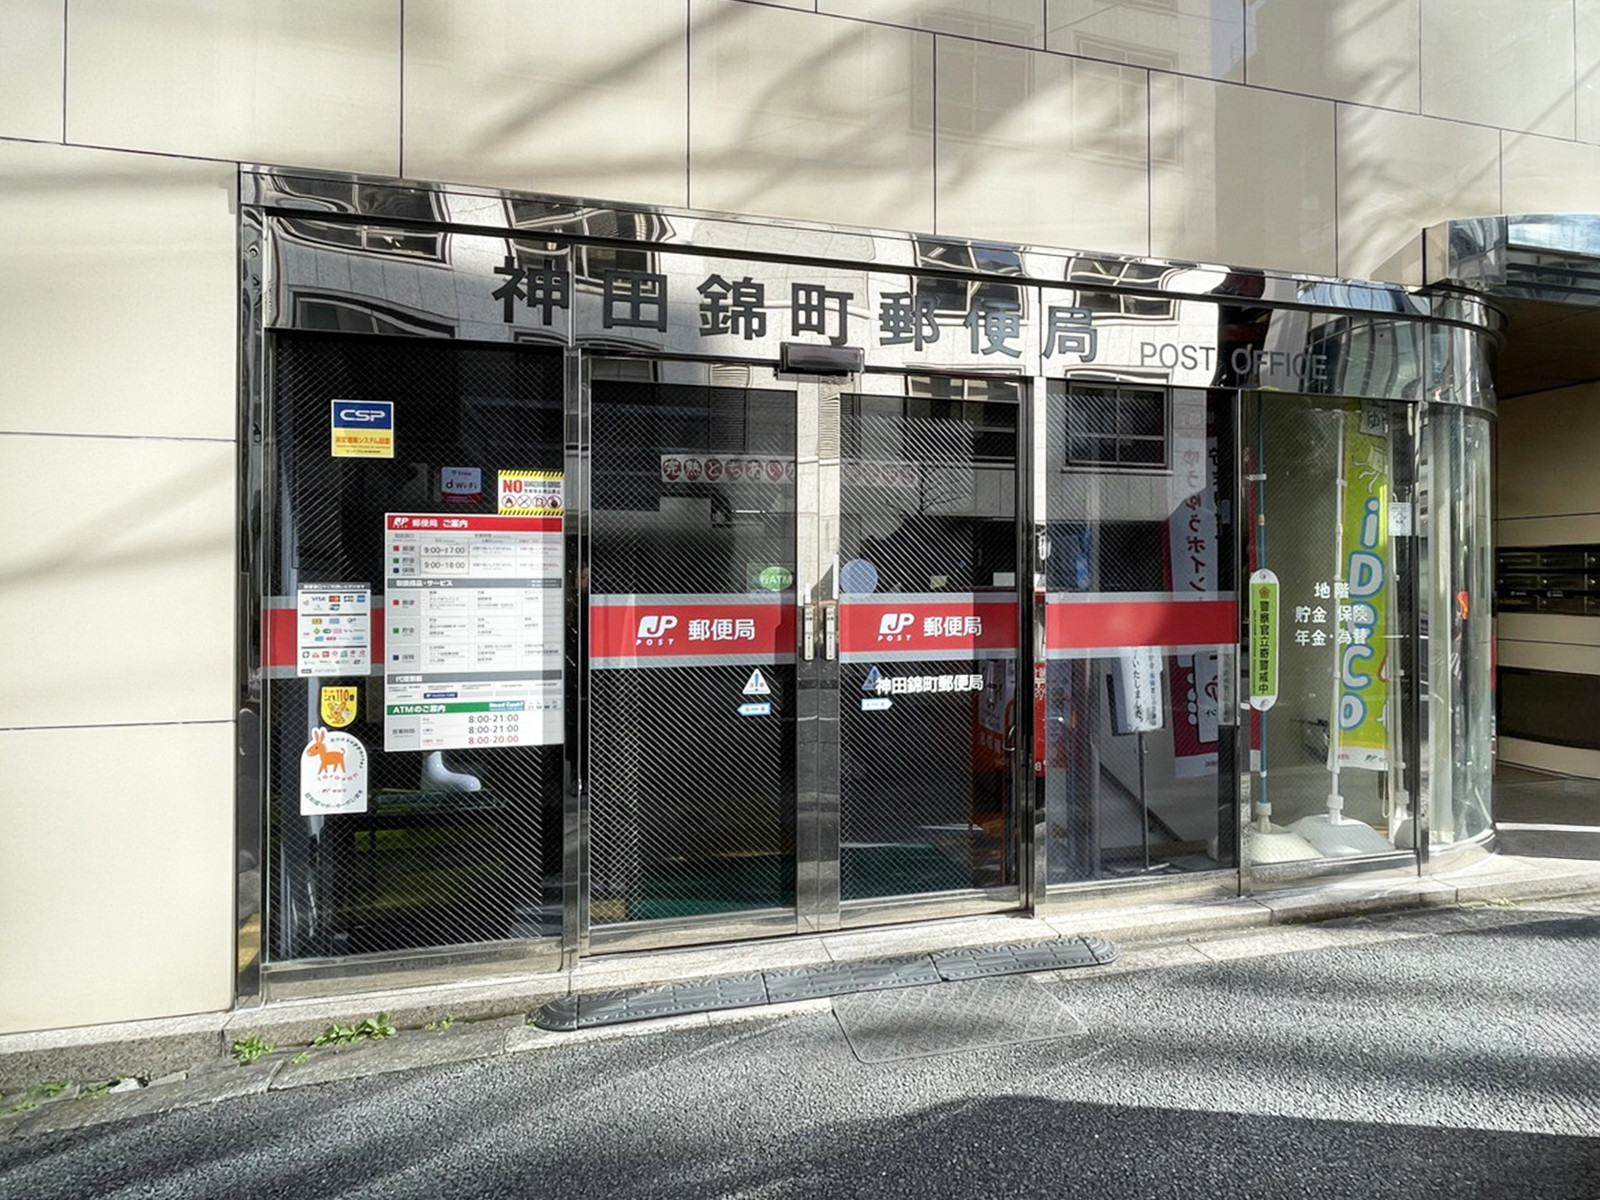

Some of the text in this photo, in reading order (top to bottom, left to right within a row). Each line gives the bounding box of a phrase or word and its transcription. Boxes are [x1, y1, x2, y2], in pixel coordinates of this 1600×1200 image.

[491, 255, 1098, 363] 神田錦町郵便局
[1140, 341, 1328, 380] POST OFFICE
[340, 409, 385, 421] CSP
[502, 480, 523, 493] NO
[1314, 582, 1350, 599] 地階
[879, 613, 915, 634] JP
[1294, 604, 1369, 624] 貯金 保険
[637, 615, 678, 638] JP
[688, 618, 755, 641] 郵便局
[923, 616, 982, 637] 郵便局
[635, 638, 674, 646] POST
[877, 634, 912, 642] POST
[1294, 627, 1369, 647] 年金・為替
[875, 674, 984, 695] 神田錦町郵便局
[468, 714, 519, 723] 8:00-21:00
[468, 724, 519, 734] 8:00-21:00
[468, 735, 519, 745] 8:00-20:00
